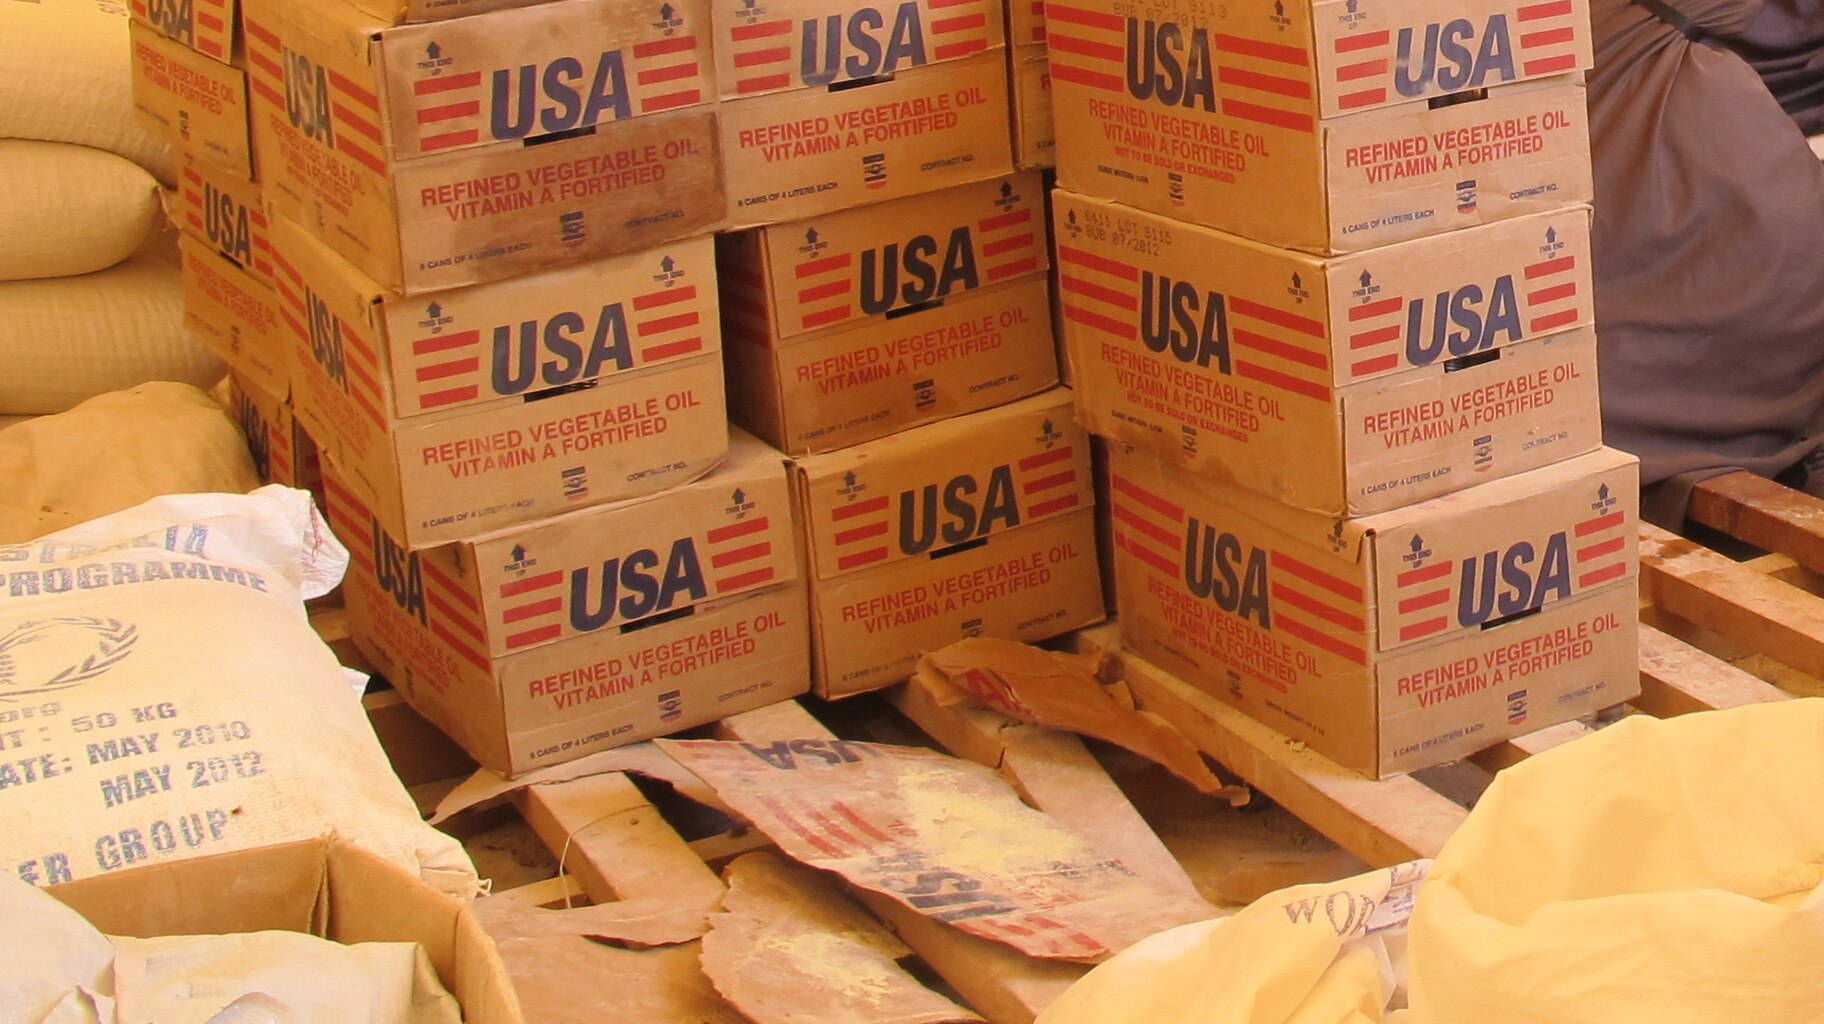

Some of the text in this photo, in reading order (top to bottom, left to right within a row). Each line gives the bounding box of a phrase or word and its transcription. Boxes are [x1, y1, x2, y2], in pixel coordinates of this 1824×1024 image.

[801, 1, 927, 86] USA
[1126, 17, 1216, 113] USA
[1394, 14, 1515, 97] USA
[282, 46, 337, 149] USA
[490, 50, 632, 140] USA
[739, 87, 986, 148] REFINED VEGETABLE OIL
[1089, 98, 1270, 157] REFINED VEGETABLE OIL
[421, 138, 698, 207] REFINED VEGETABLE OIL
[761, 112, 958, 162] VITAMIN A FORTIFIED
[1104, 123, 1245, 173] VITAMIN A FORTIFIED
[1346, 110, 1570, 168] REFINED VEGETABLE OIL
[1366, 135, 1543, 184] VITAMIN A FORTIFIED
[204, 182, 252, 267] USA
[446, 164, 665, 222] VITAMIN A FORTIFIED
[860, 226, 979, 315] USA
[305, 285, 348, 394] USA
[491, 302, 634, 396] USA
[797, 308, 1029, 383] REFINED VEGETABLE OIL
[1141, 270, 1232, 376] USA
[1406, 274, 1522, 367] USA
[818, 333, 1002, 395] VITAMIN A FORTIFIED
[1364, 362, 1580, 435] REFINED VEGETABLE OIL
[423, 391, 700, 467] REFINED VEGETABLE OIL
[448, 417, 668, 479] VITAMIN A FORTIFIED
[1383, 389, 1555, 450] VITAMIN A FORTIFIED
[899, 464, 1020, 556] USA
[371, 514, 429, 627] USA
[570, 537, 707, 632] USA
[842, 543, 1078, 623] REFINED VEGETABLE OIL
[864, 568, 1051, 634] VITAMIN A FORTIFIED
[1185, 516, 1271, 631] USA
[1458, 531, 1571, 628] USA
[529, 611, 786, 699] REFINED VEGETABLE OIL
[553, 638, 756, 711] VITAMIN A FORTIFIED
[1398, 612, 1620, 696] REFINED VEGETABLE OIL
[1417, 639, 1593, 709] VITAMIN A FORTIFIED
[71, 702, 177, 733] 50 KG
[86, 732, 160, 766] MAY
[173, 720, 251, 749] 2010
[100, 750, 265, 808] MAY 2012
[94, 807, 228, 871] GROUP
